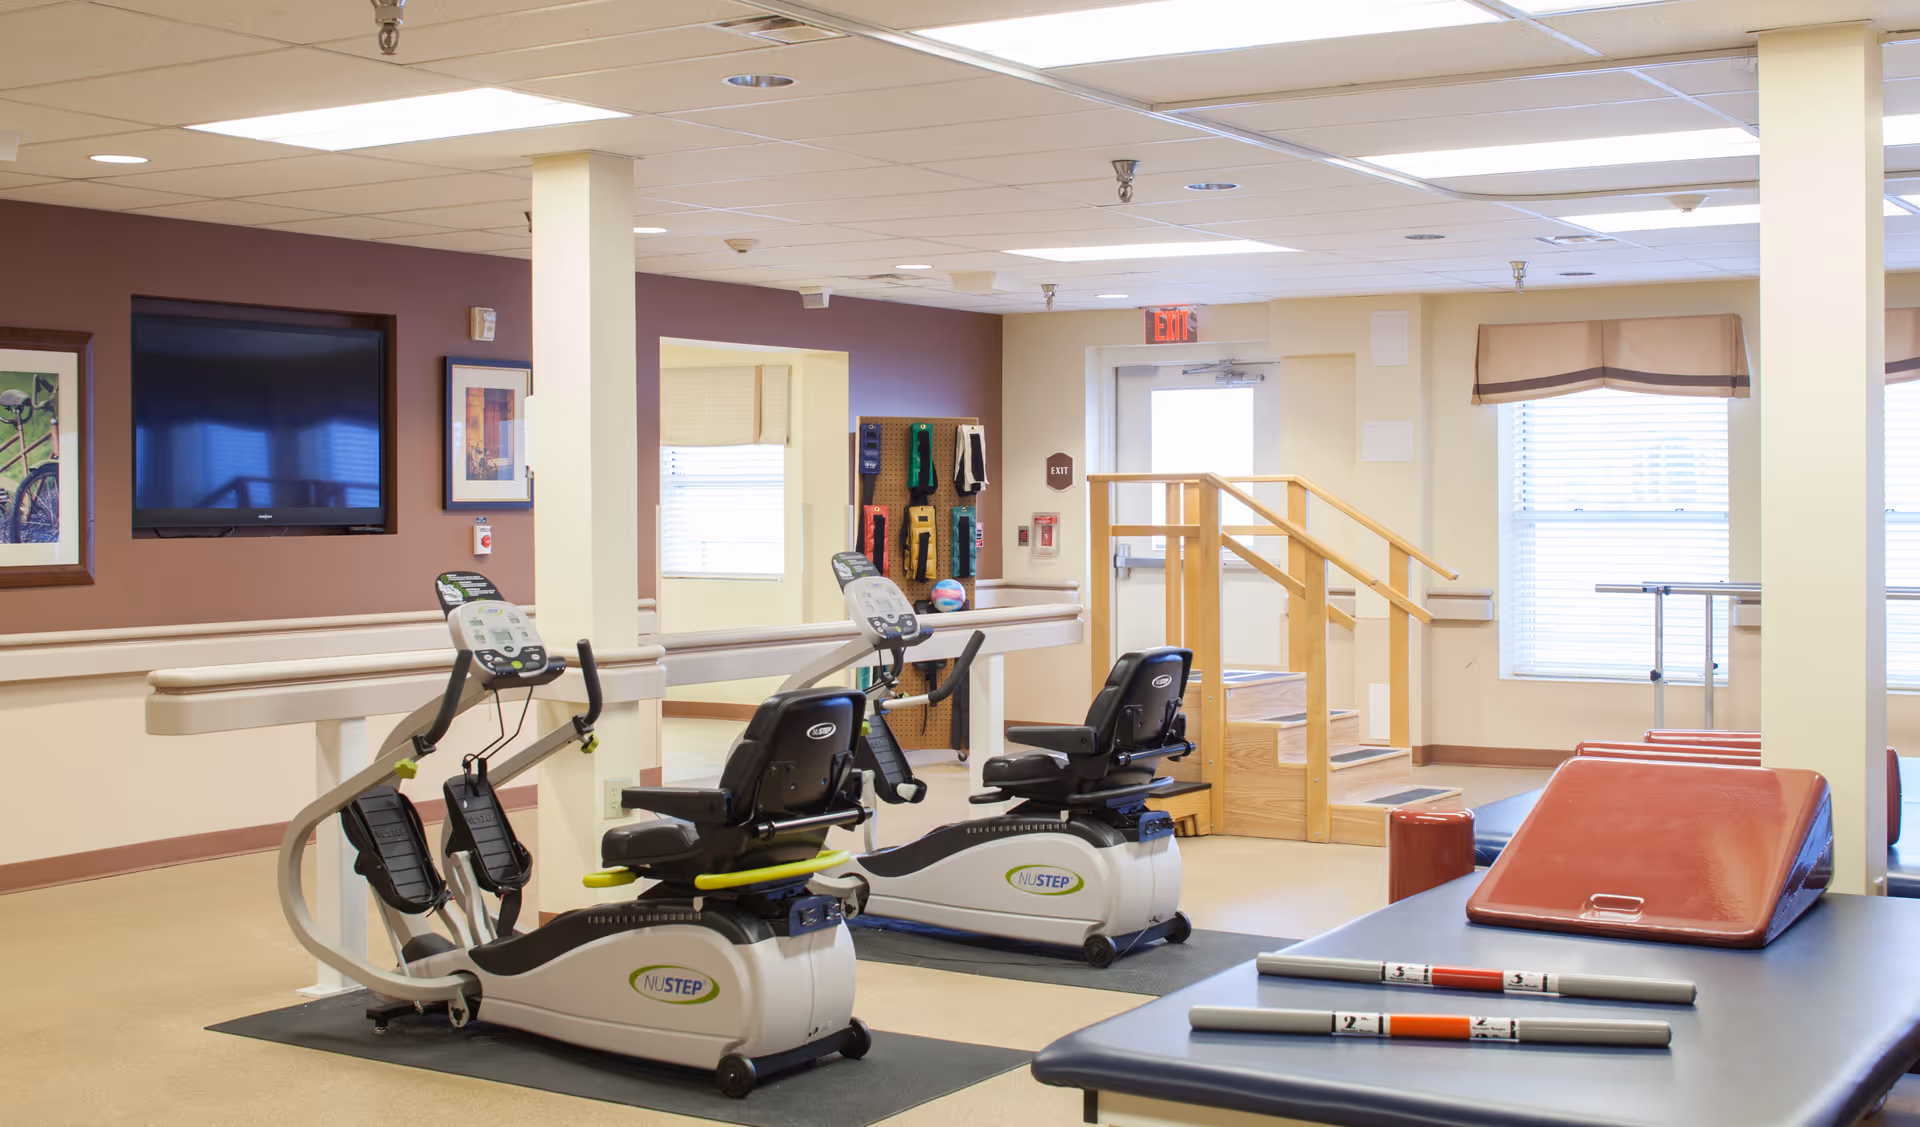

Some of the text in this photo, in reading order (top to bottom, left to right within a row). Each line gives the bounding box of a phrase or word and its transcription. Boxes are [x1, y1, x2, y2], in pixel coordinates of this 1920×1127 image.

[1154, 309, 1189, 341] EXIT
[1051, 466, 1069, 475] EXIT
[1019, 872, 1070, 888] NUSTEP
[644, 975, 703, 995] NUSTEP
[1511, 973, 1523, 984] 3
[1344, 1016, 1356, 1028] 2
